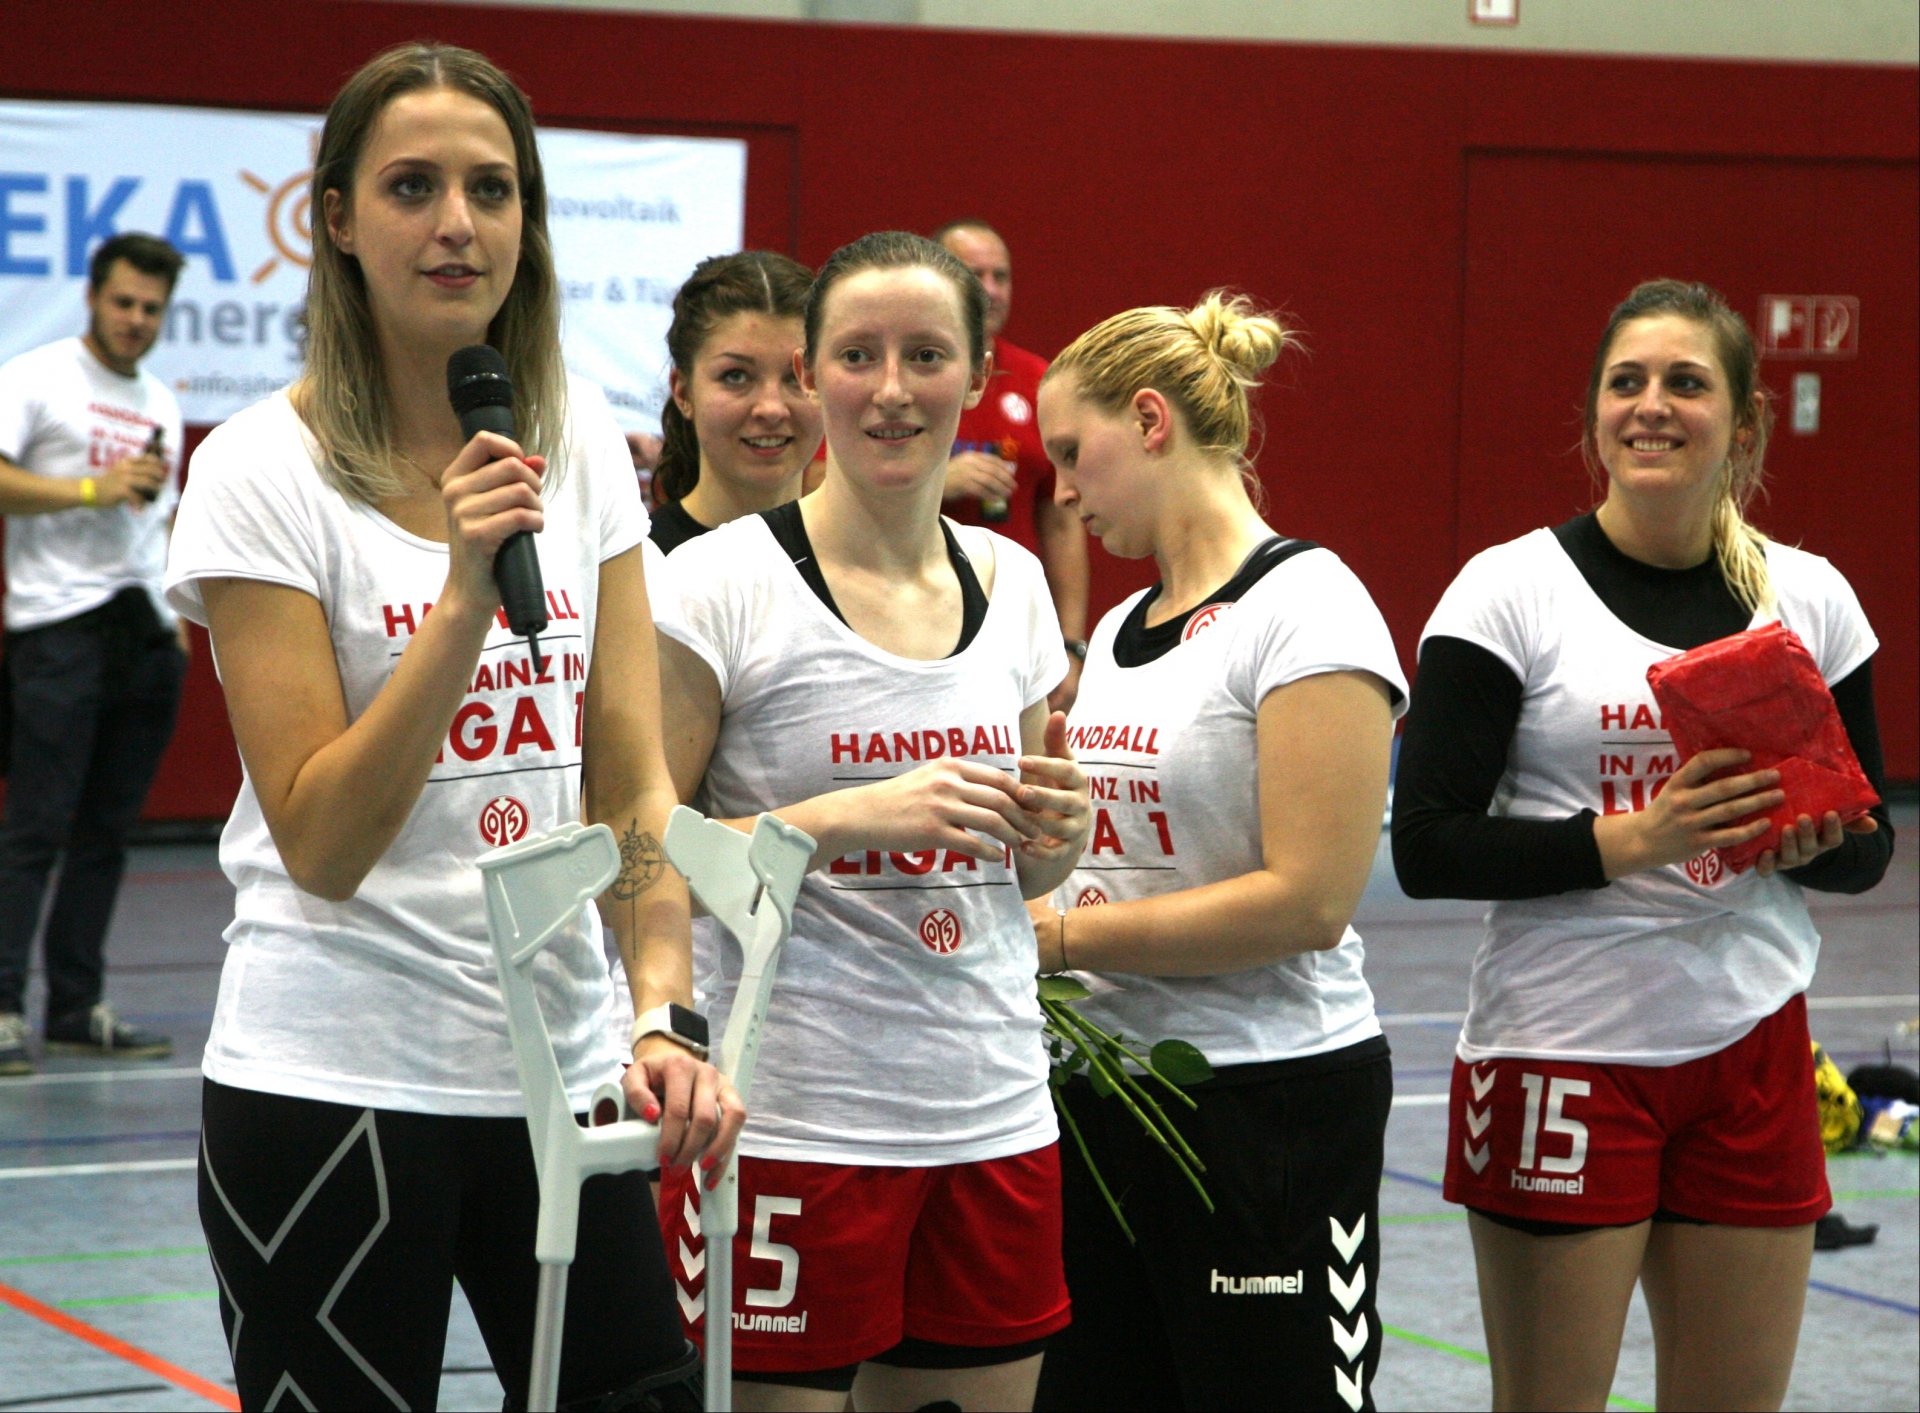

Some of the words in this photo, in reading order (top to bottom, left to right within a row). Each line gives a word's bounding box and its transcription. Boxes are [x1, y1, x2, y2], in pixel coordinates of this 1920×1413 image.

[164, 300, 308, 362] nerg
[466, 654, 555, 693] AINZ
[563, 653, 585, 681] IN
[435, 696, 556, 764] GA
[831, 725, 1015, 764] HANDBALL
[1065, 725, 1160, 755] ANDBALL
[1600, 755, 1634, 776] IN
[1128, 779, 1162, 804] IN
[1148, 811, 1175, 856] 1
[1518, 1072, 1592, 1174] 15
[1511, 1168, 1584, 1195] hummel
[745, 1194, 803, 1308] 5
[1211, 1268, 1304, 1294] hummel
